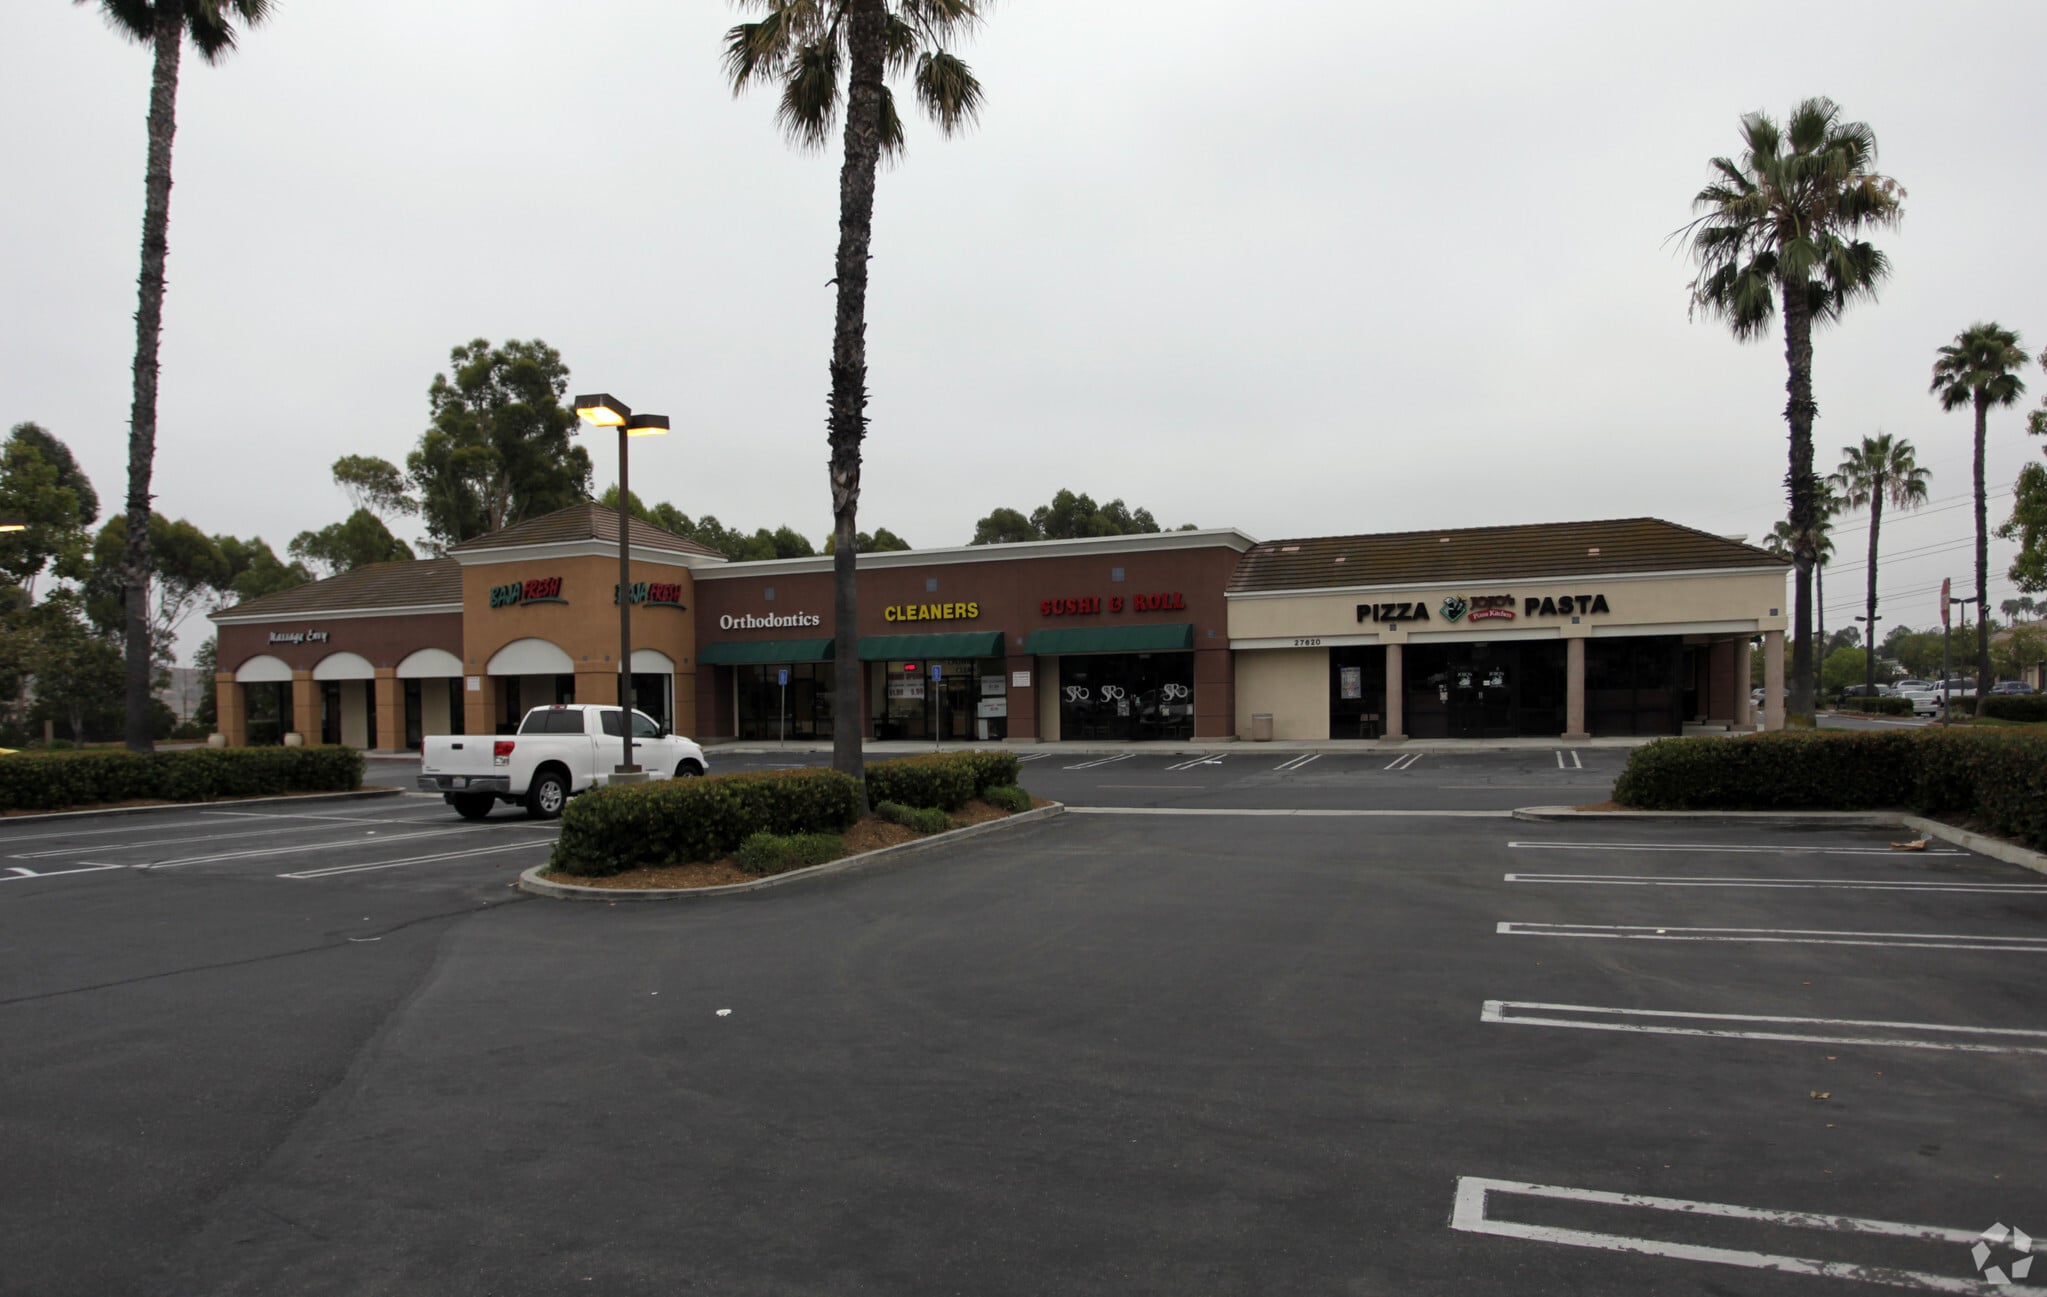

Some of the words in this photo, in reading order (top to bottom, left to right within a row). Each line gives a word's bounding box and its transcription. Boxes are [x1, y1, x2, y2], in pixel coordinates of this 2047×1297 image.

[490, 582, 522, 608] BAJA
[523, 577, 562, 600] FRESH
[648, 582, 681, 602] FRESH
[884, 602, 979, 622] CLEANERS
[1040, 596, 1100, 616] SUSHI
[1108, 594, 1123, 612] &
[1133, 591, 1185, 612] ROLL
[1356, 602, 1430, 623] PIZZA
[1525, 594, 1610, 616] PASTA
[719, 611, 820, 630] Orthodontics
